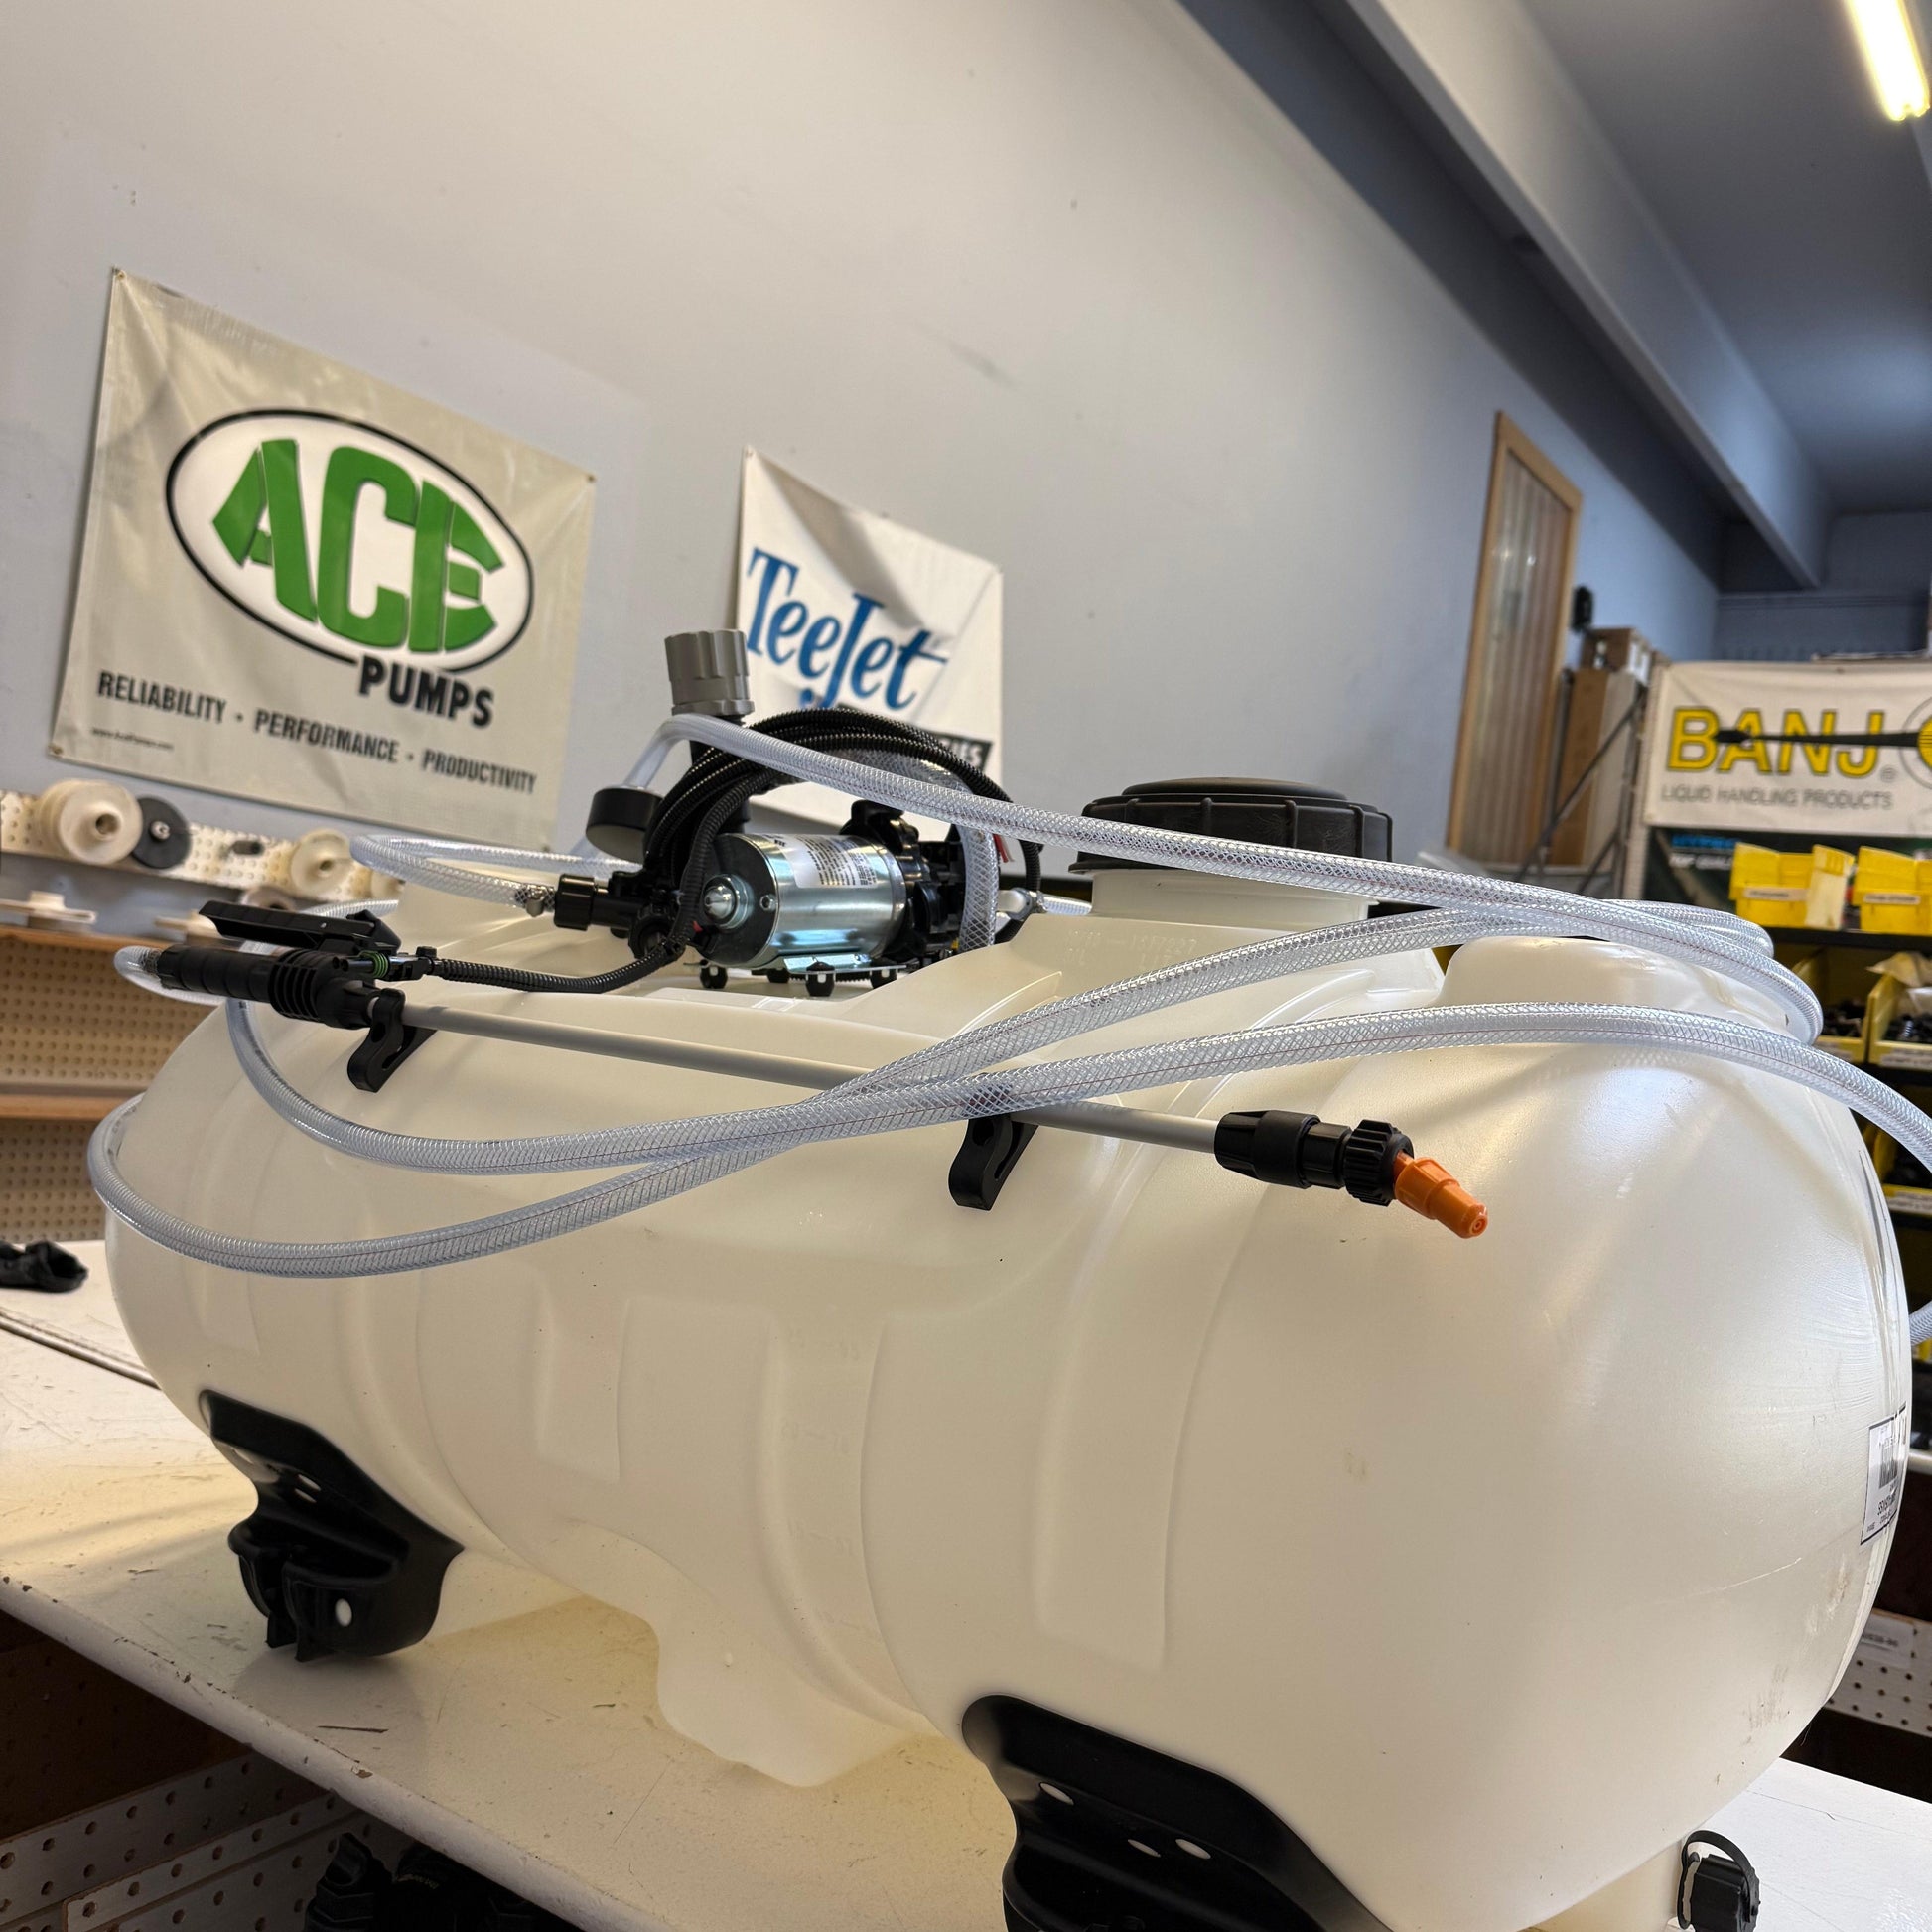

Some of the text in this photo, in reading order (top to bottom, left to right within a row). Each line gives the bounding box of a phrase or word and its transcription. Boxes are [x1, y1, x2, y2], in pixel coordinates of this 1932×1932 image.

[211, 438, 505, 655] ACE
[745, 546, 949, 711] TeeJet
[97, 669, 538, 795] RELIABILITY PERFORMANCE PRODUCTIVITY
[357, 654, 494, 729] PUMPS
[1667, 706, 1932, 779] BANJ
[1660, 784, 1893, 811] LIQUID HANDLING PRODUCTS
